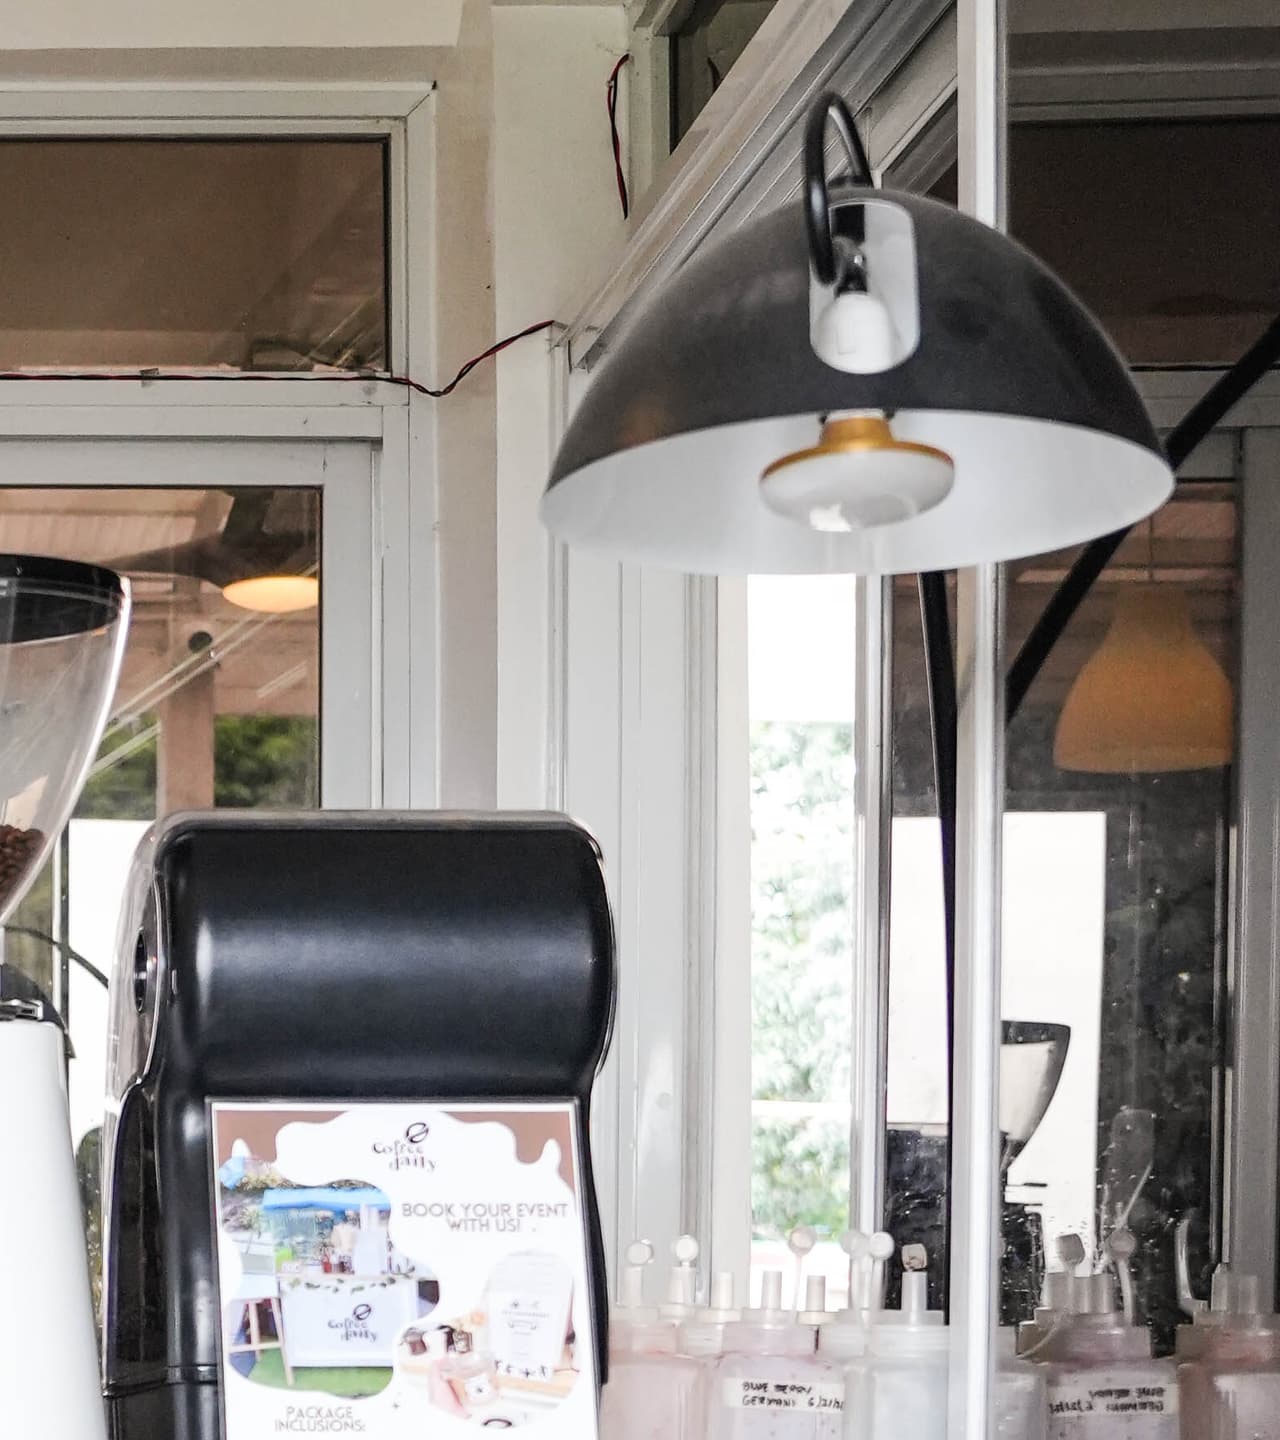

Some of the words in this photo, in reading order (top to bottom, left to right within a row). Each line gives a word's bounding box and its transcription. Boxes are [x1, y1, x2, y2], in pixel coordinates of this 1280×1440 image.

[372, 1139, 424, 1155] Coffee
[401, 1203, 456, 1218] BOOK
[460, 1203, 512, 1218] YOUR
[517, 1203, 568, 1218] EVENT
[446, 1218, 490, 1232] WITH
[495, 1218, 521, 1232] US!
[285, 1406, 354, 1420] PACKAGE
[274, 1419, 366, 1433] INCLUSIONS:
